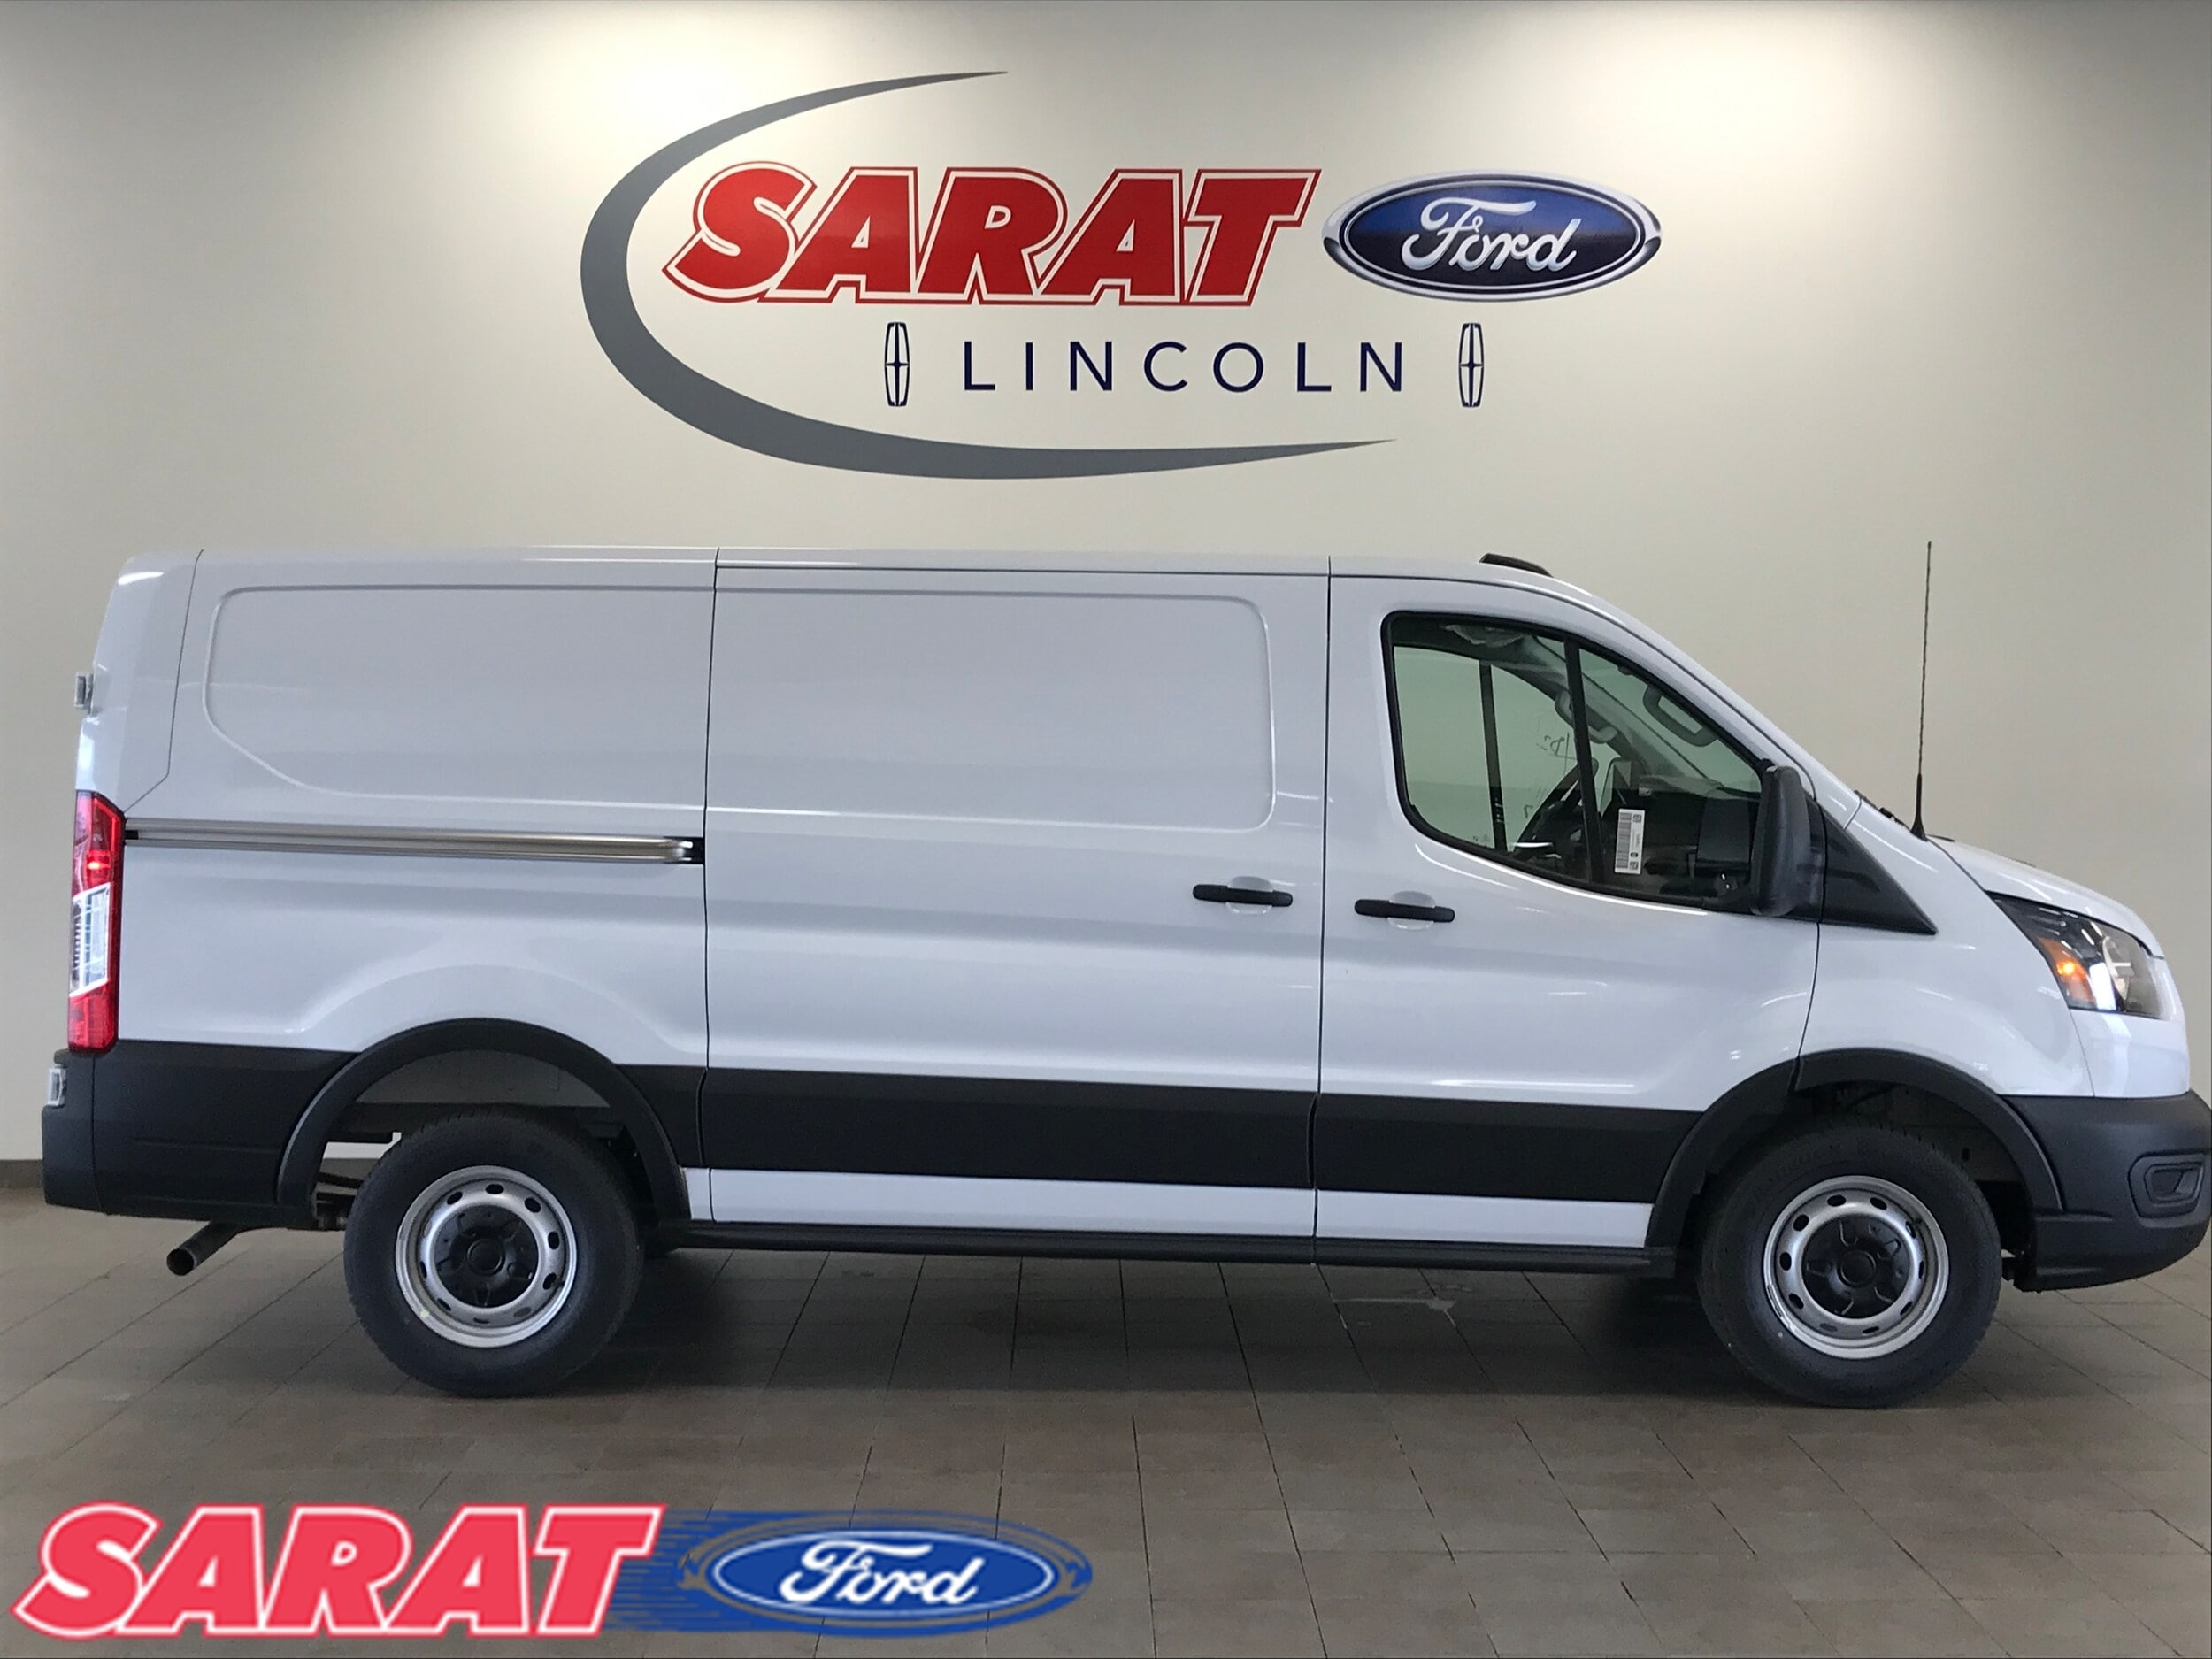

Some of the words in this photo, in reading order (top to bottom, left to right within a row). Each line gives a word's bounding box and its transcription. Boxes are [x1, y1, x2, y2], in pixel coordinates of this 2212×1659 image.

[663, 161, 1321, 306] SARAT
[1402, 196, 1581, 271] Ford
[964, 341, 1403, 392] LINCOLN
